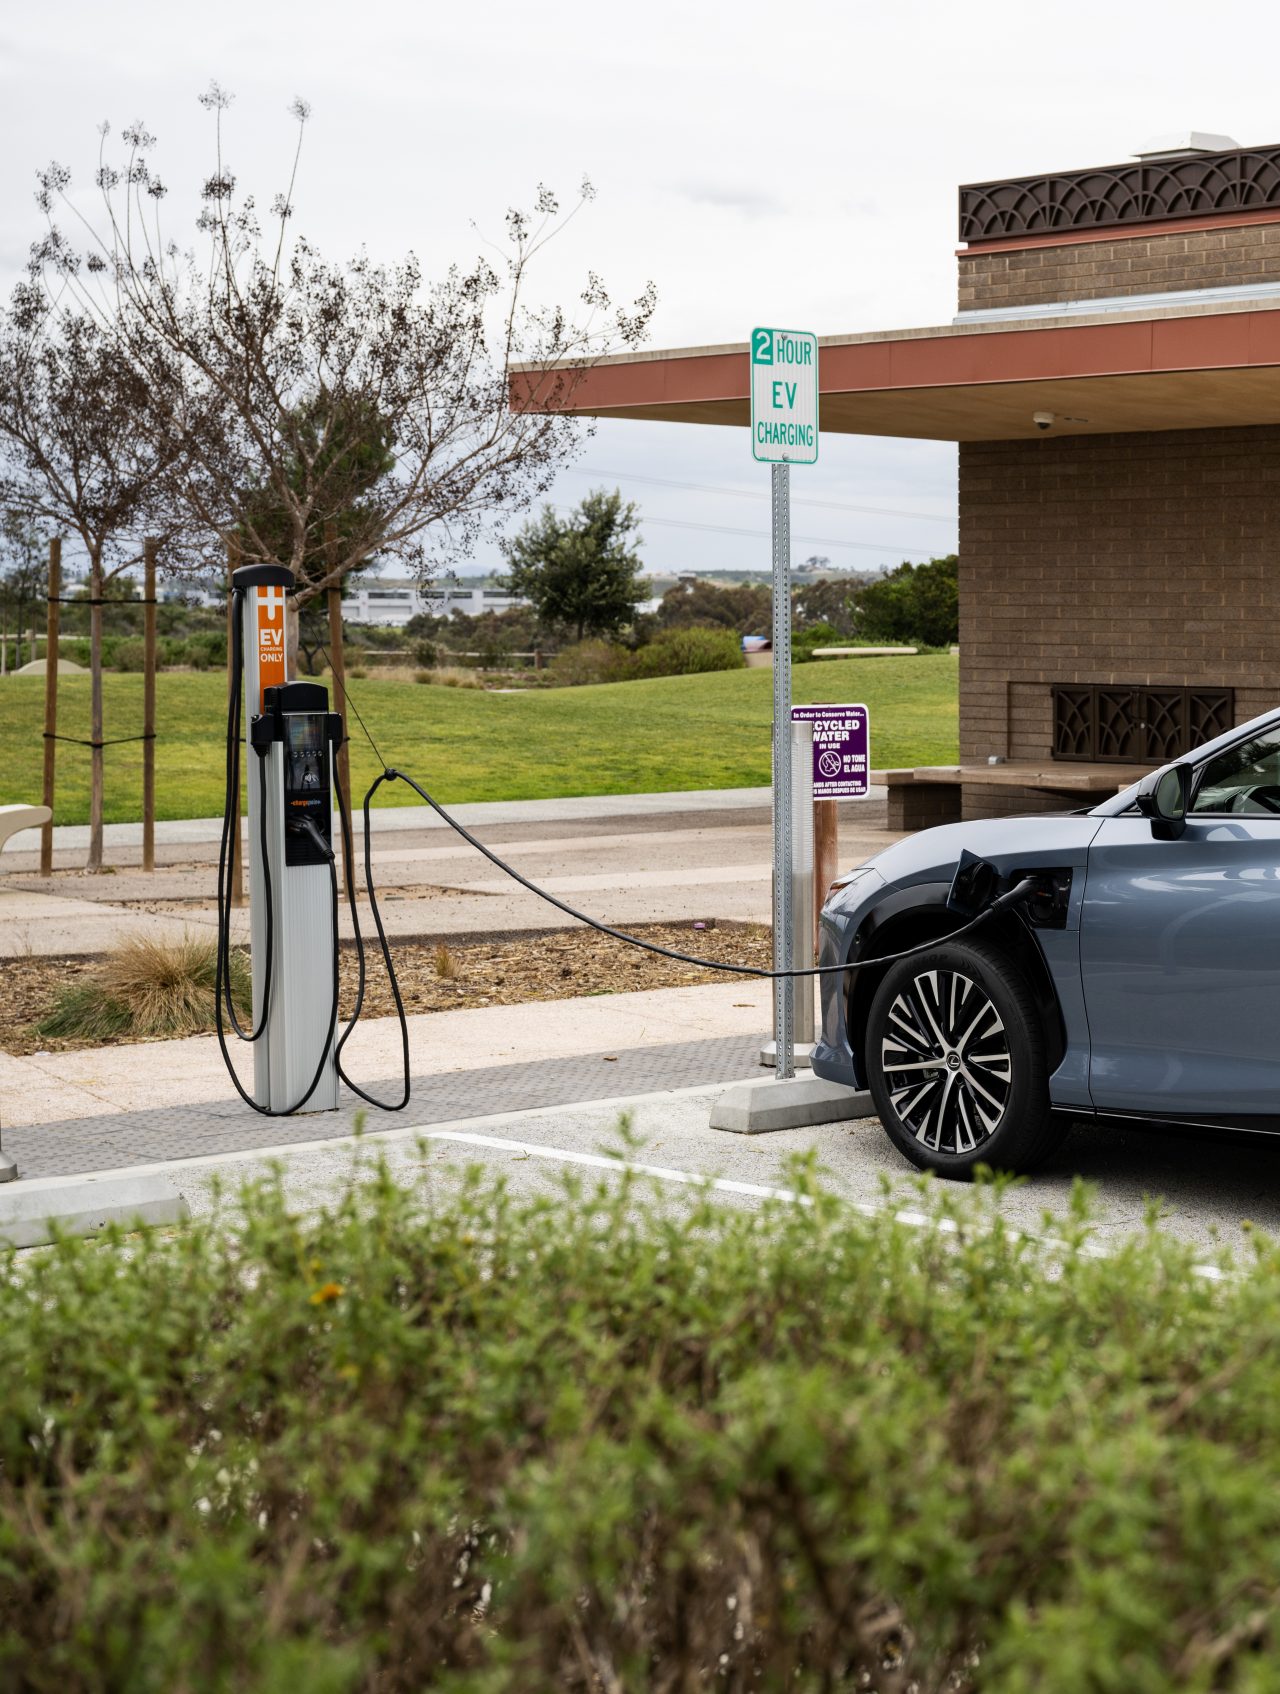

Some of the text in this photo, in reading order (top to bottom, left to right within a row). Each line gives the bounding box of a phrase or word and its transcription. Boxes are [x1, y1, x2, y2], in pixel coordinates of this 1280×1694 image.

[755, 331, 812, 366] 2 HOUR
[772, 380, 798, 410] EV
[757, 421, 814, 447] CHARGING
[259, 628, 283, 646] EV
[260, 652, 284, 663] ONLY
[813, 720, 860, 731] CYCLED
[843, 754, 866, 763] NO TOME
[844, 764, 865, 773] EL AGUA
